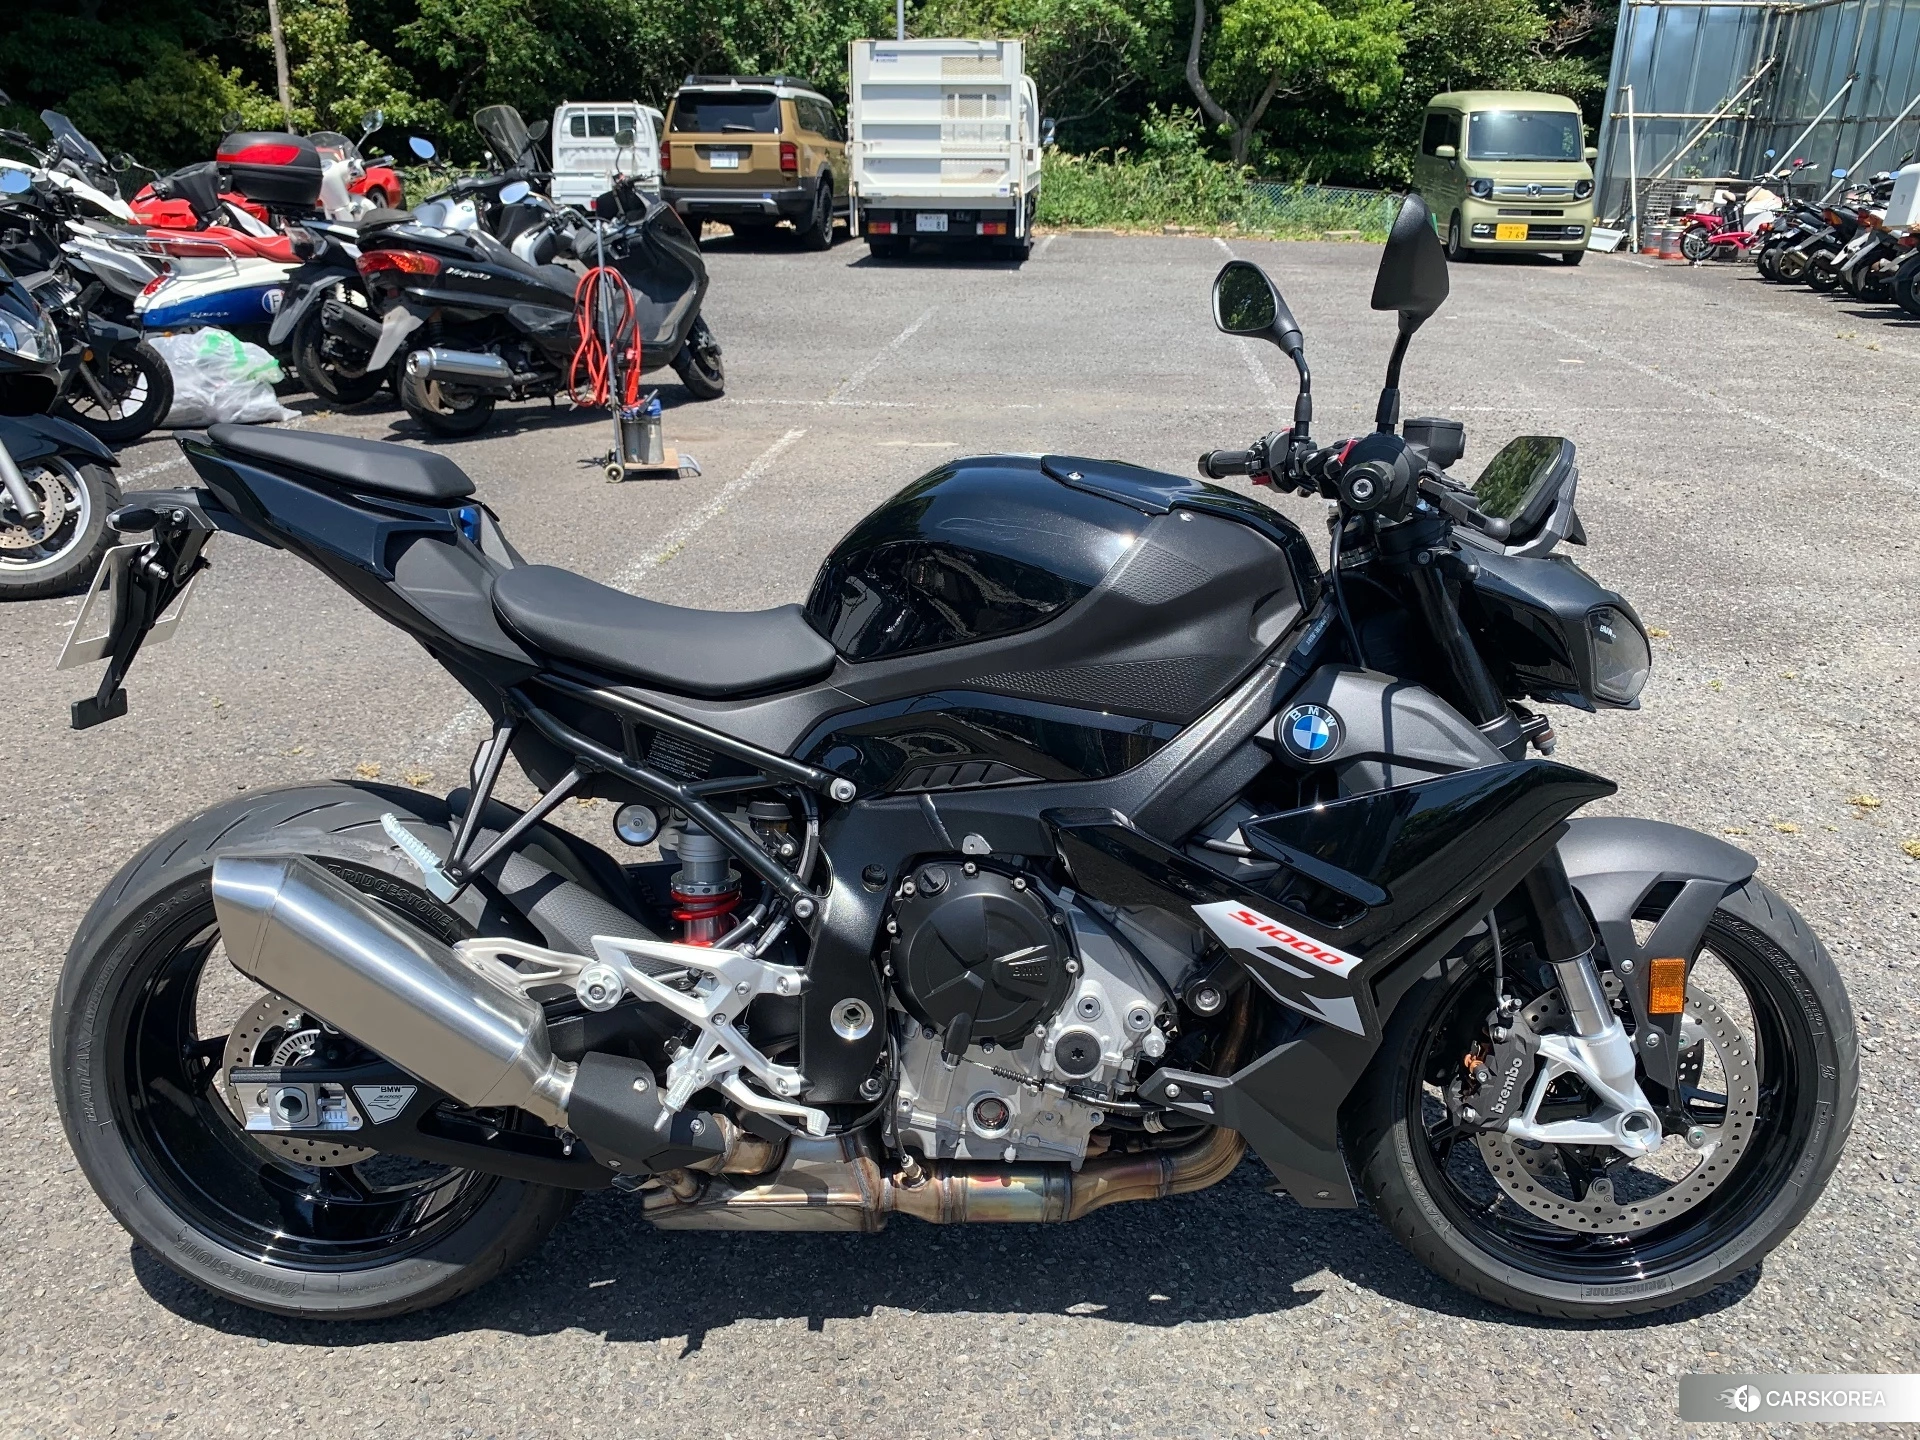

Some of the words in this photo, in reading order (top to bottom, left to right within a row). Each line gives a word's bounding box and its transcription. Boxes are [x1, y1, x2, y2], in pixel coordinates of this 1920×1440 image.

[1289, 706, 1337, 728] BMW
[327, 863, 453, 927] BRIDGESTONE
[1228, 911, 1345, 965] S1000
[1012, 966, 1045, 977] BMW
[1491, 1057, 1523, 1114] brembo
[174, 1236, 301, 1299] BRIDGESTONE
[1585, 1277, 1668, 1297] BRIDGESTONE
